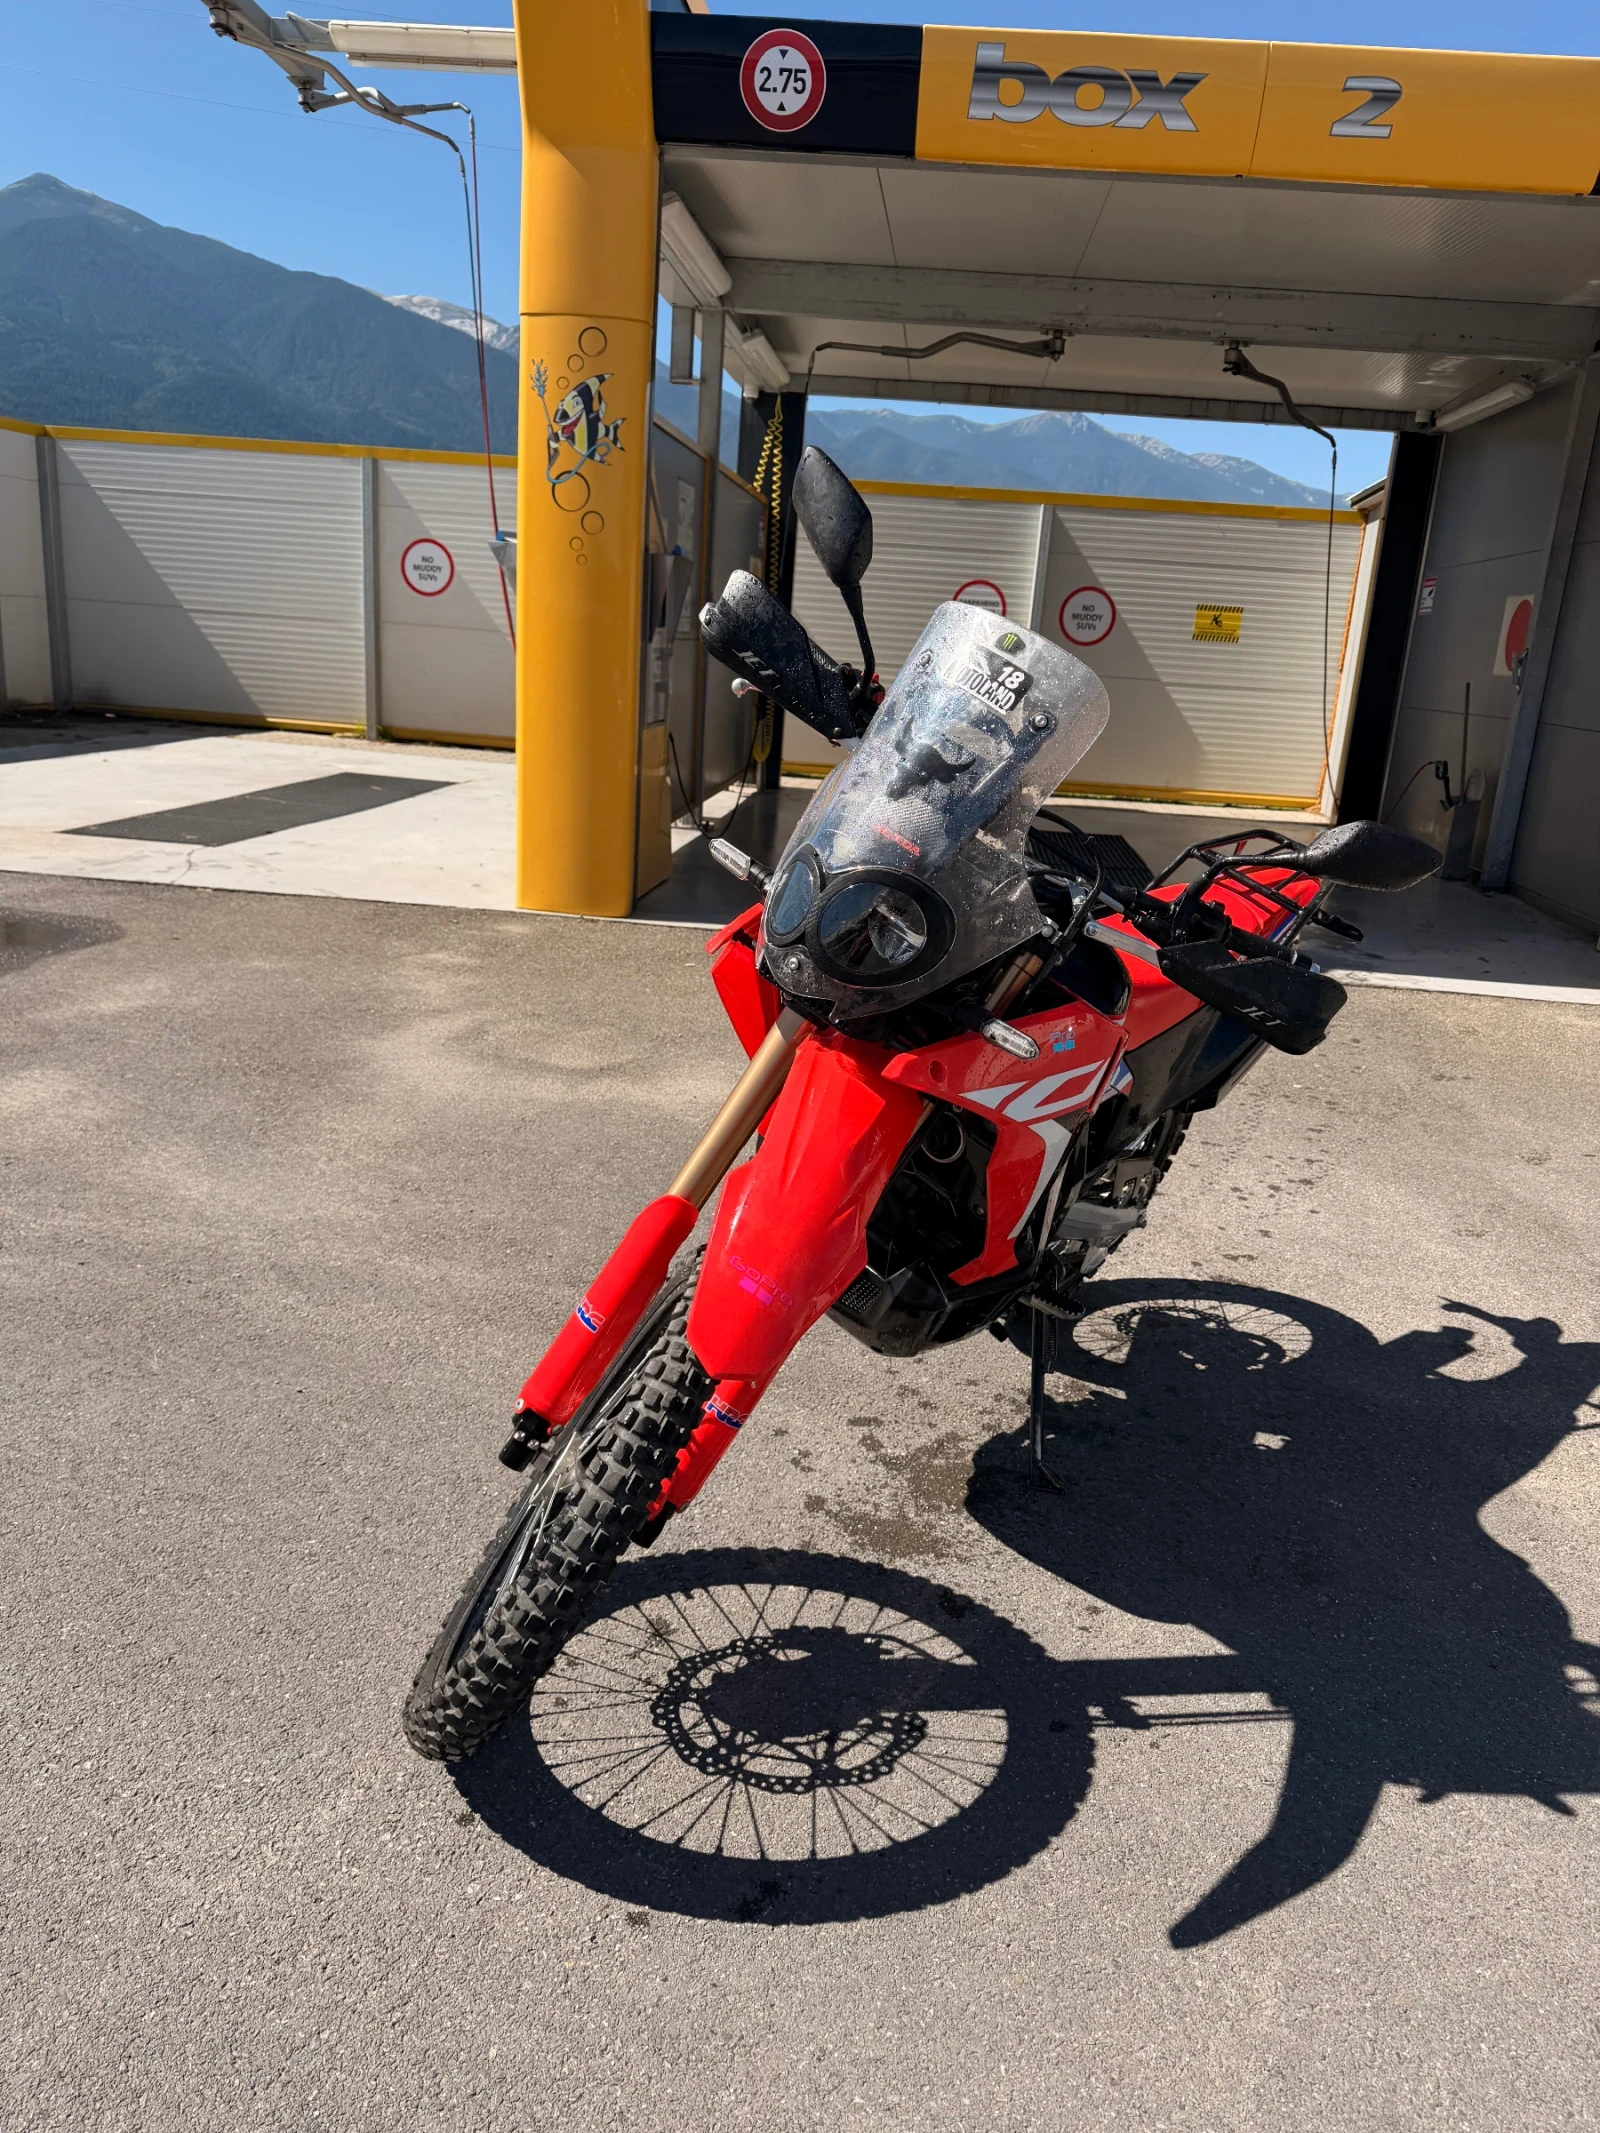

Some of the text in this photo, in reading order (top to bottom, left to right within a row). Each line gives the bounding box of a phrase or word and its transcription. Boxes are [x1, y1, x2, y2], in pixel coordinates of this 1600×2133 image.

[758, 66, 807, 95] 2.75
[967, 41, 1403, 139] box 2
[412, 563, 443, 573] MUDDY
[421, 555, 435, 564] NO
[418, 572, 438, 582] SUVs
[1071, 612, 1104, 622] MUDDY
[1081, 604, 1096, 613] NO
[1076, 621, 1097, 631] SUVs
[731, 648, 780, 678] JET
[997, 666, 1025, 689] 18
[1233, 1005, 1287, 1026] JET
[729, 1255, 794, 1306] GoPro
[576, 1296, 606, 1334] RC
